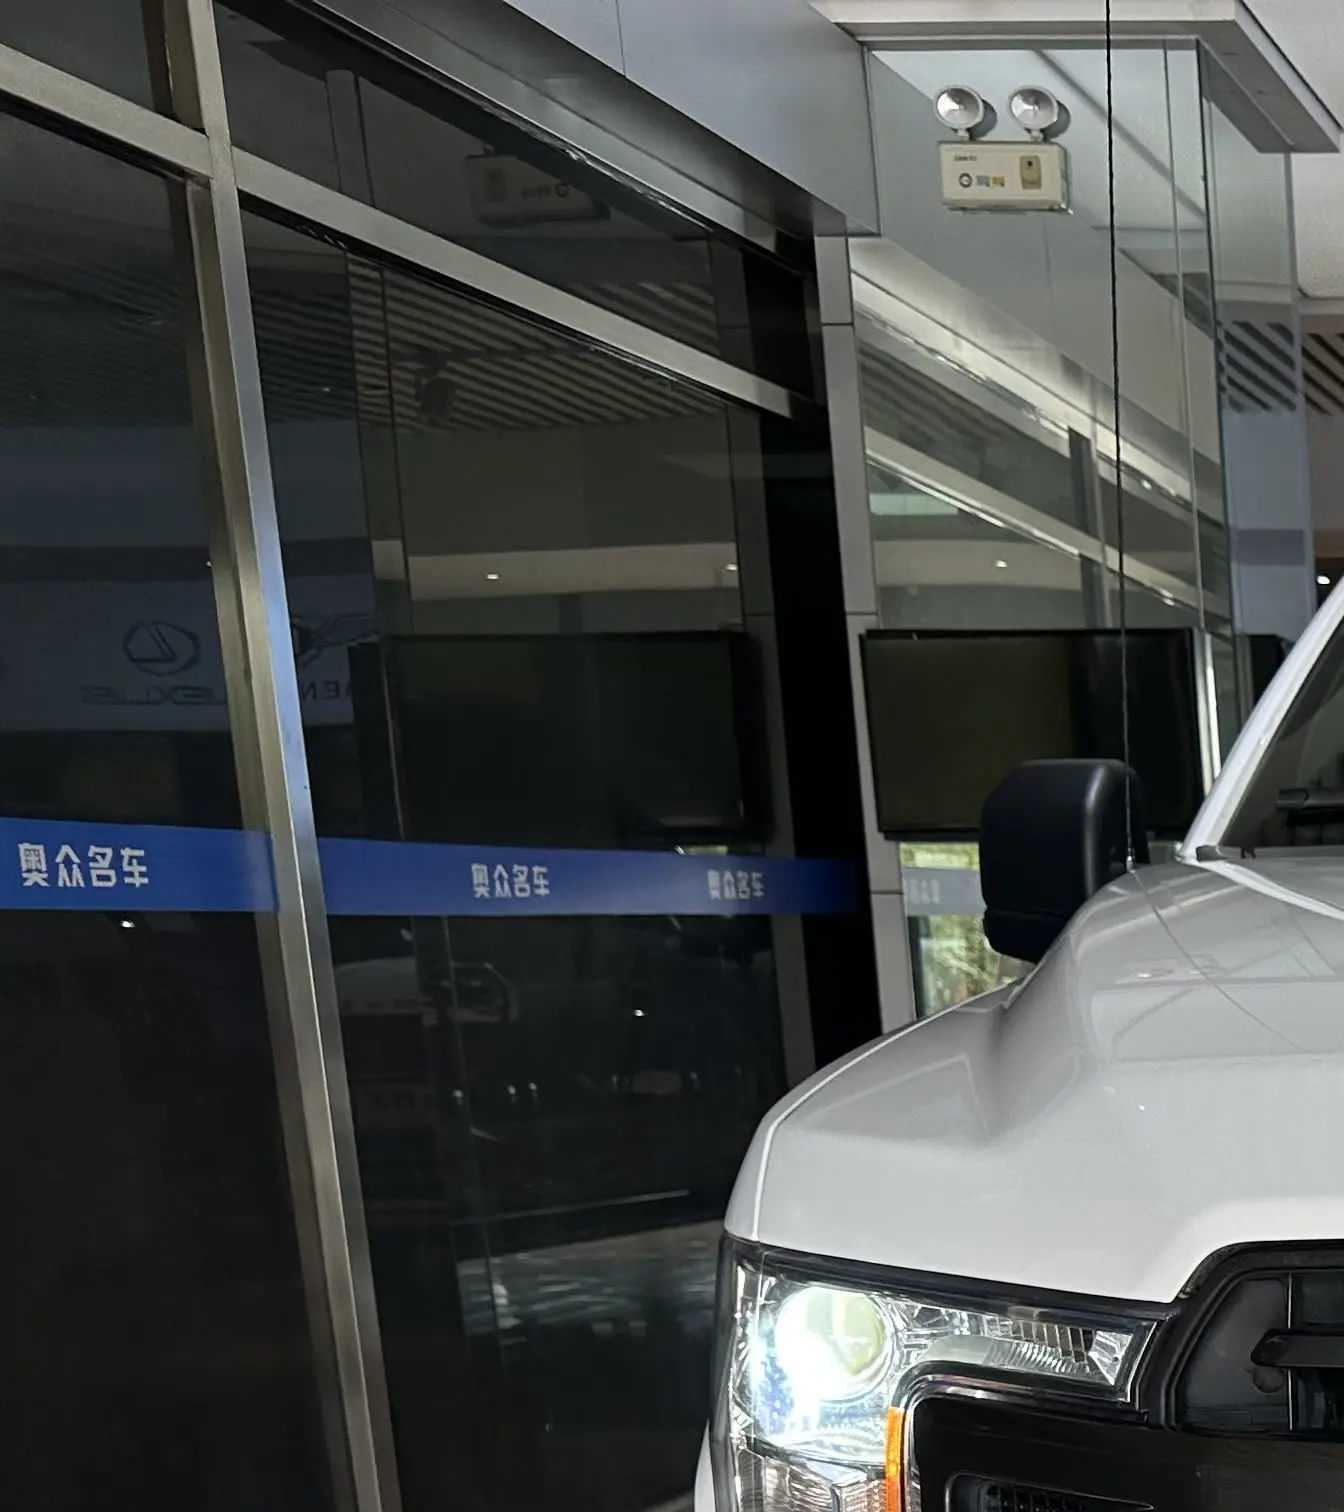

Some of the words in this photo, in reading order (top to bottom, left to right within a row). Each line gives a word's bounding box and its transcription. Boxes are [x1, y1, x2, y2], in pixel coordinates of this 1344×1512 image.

[18, 842, 149, 888] 奥众名车
[471, 862, 551, 899] 奥众名车
[707, 869, 765, 900] 奥众名车
